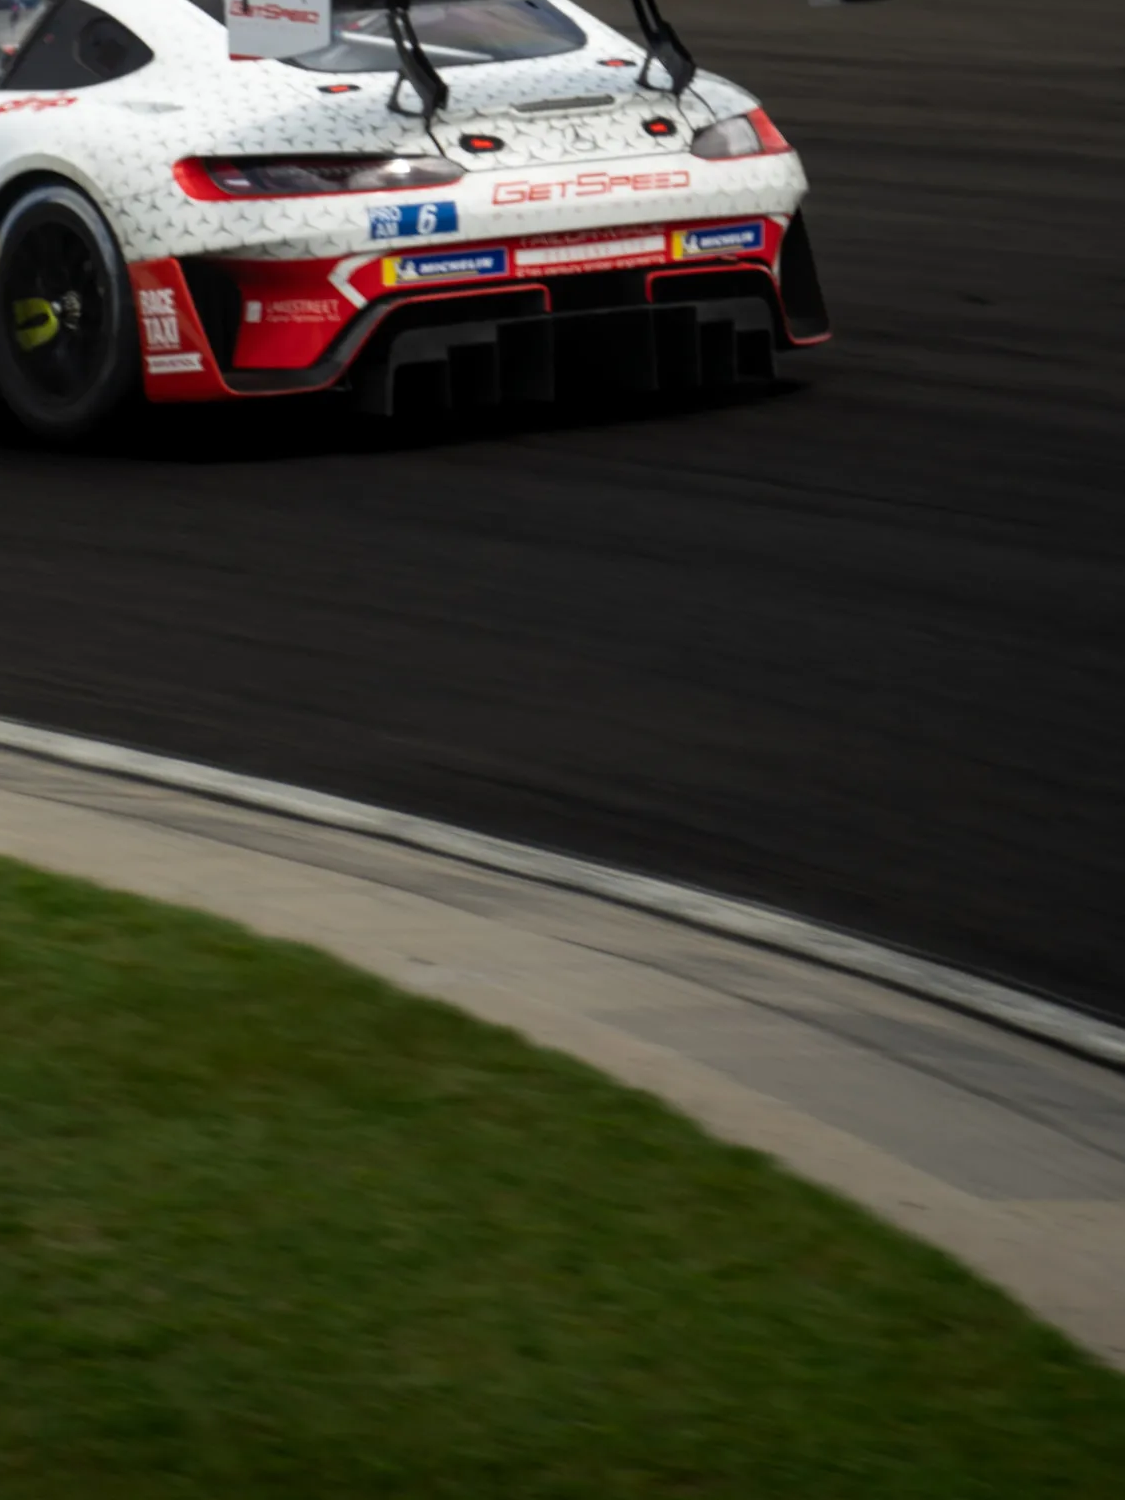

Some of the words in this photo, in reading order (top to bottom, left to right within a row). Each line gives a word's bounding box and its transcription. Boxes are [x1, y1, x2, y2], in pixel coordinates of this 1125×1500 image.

[416, 204, 438, 235] 6
[699, 231, 755, 248] MICHELIN
[419, 256, 494, 275] MICHELIN
